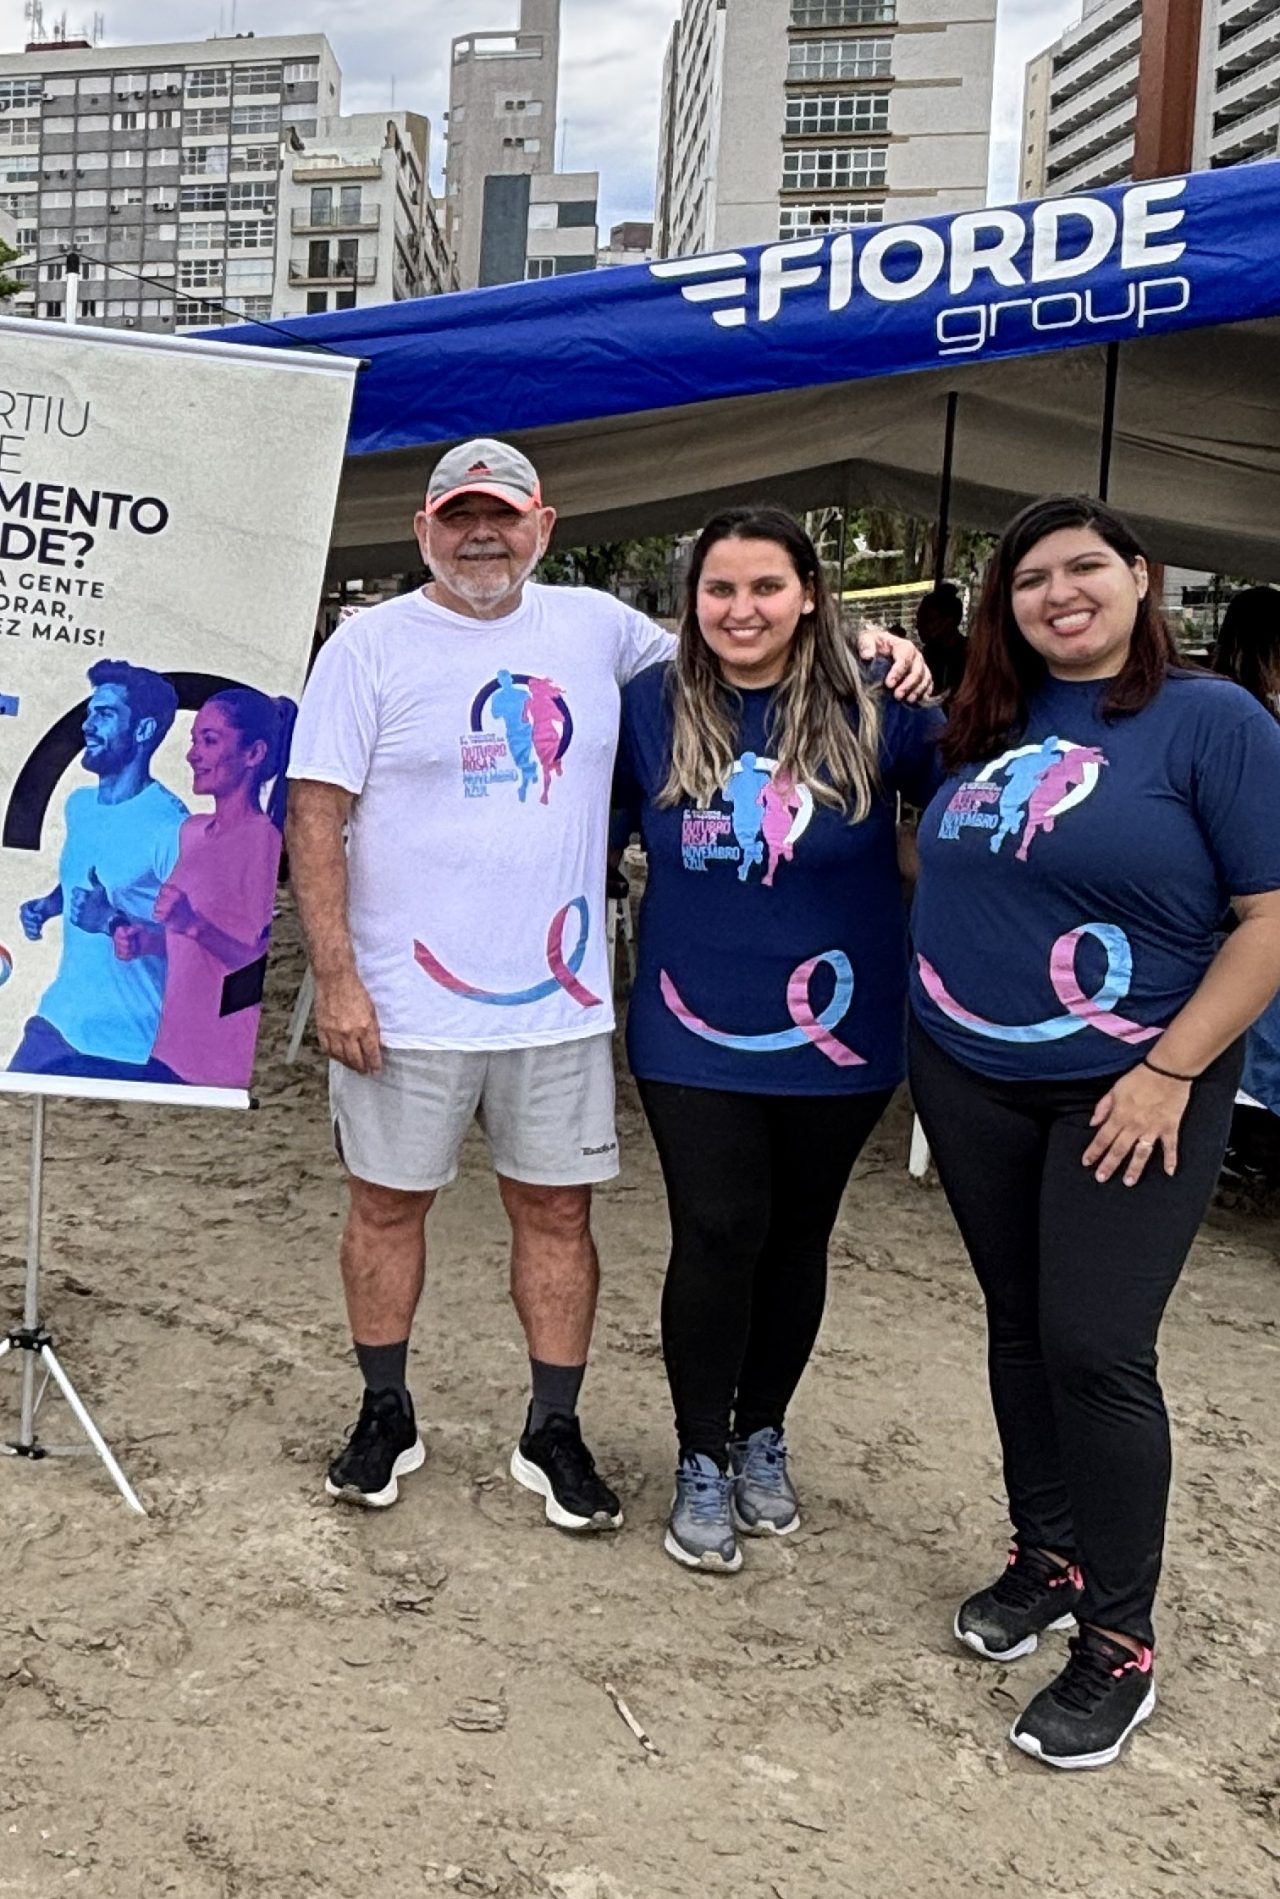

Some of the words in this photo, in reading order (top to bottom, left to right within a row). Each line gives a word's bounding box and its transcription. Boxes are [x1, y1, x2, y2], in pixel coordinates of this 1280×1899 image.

[759, 179, 1187, 321] FIORDE
[935, 275, 1190, 356] group
[18, 572, 106, 599] GENTE
[31, 621, 106, 648] MAIS!
